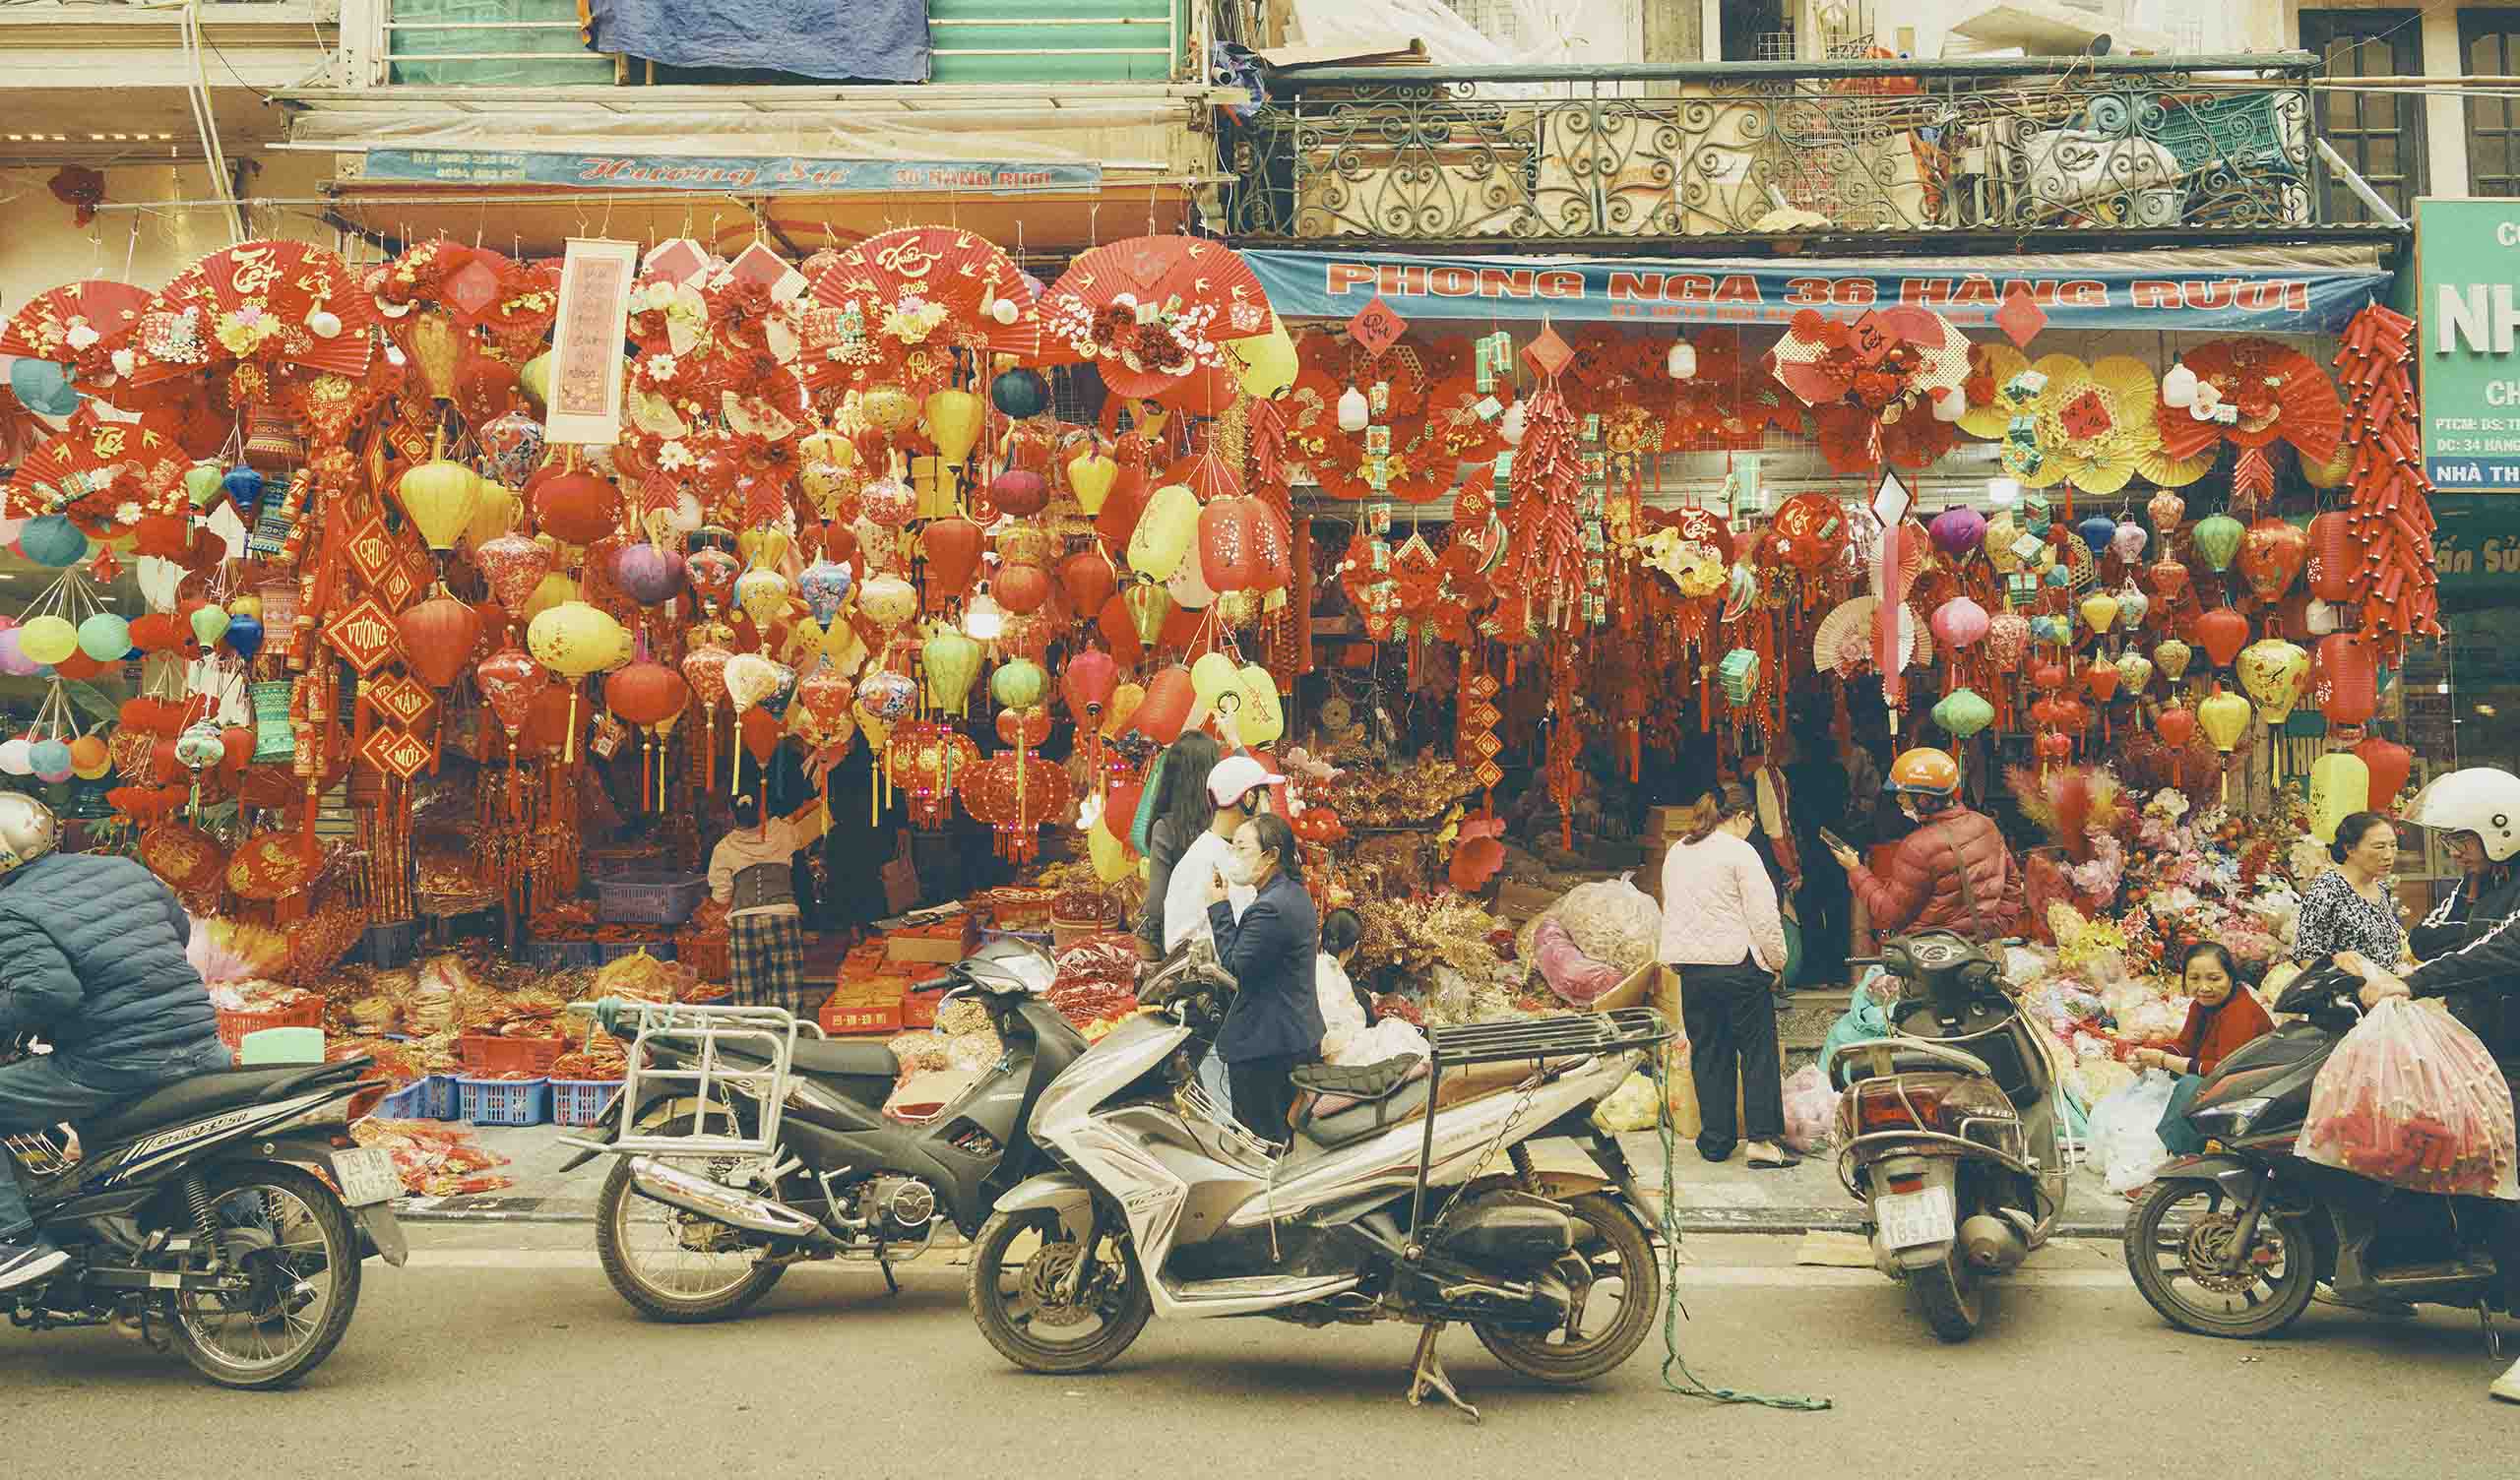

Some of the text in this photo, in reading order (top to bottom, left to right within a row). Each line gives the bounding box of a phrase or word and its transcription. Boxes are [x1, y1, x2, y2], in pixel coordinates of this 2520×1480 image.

[1326, 263, 1586, 299] PHONG
[1606, 272, 1765, 306] NGA
[1783, 276, 1879, 306] 36
[1899, 272, 2111, 307] HÀNG
[2436, 462, 2483, 481] NHÀ
[358, 532, 392, 569] CHÚC
